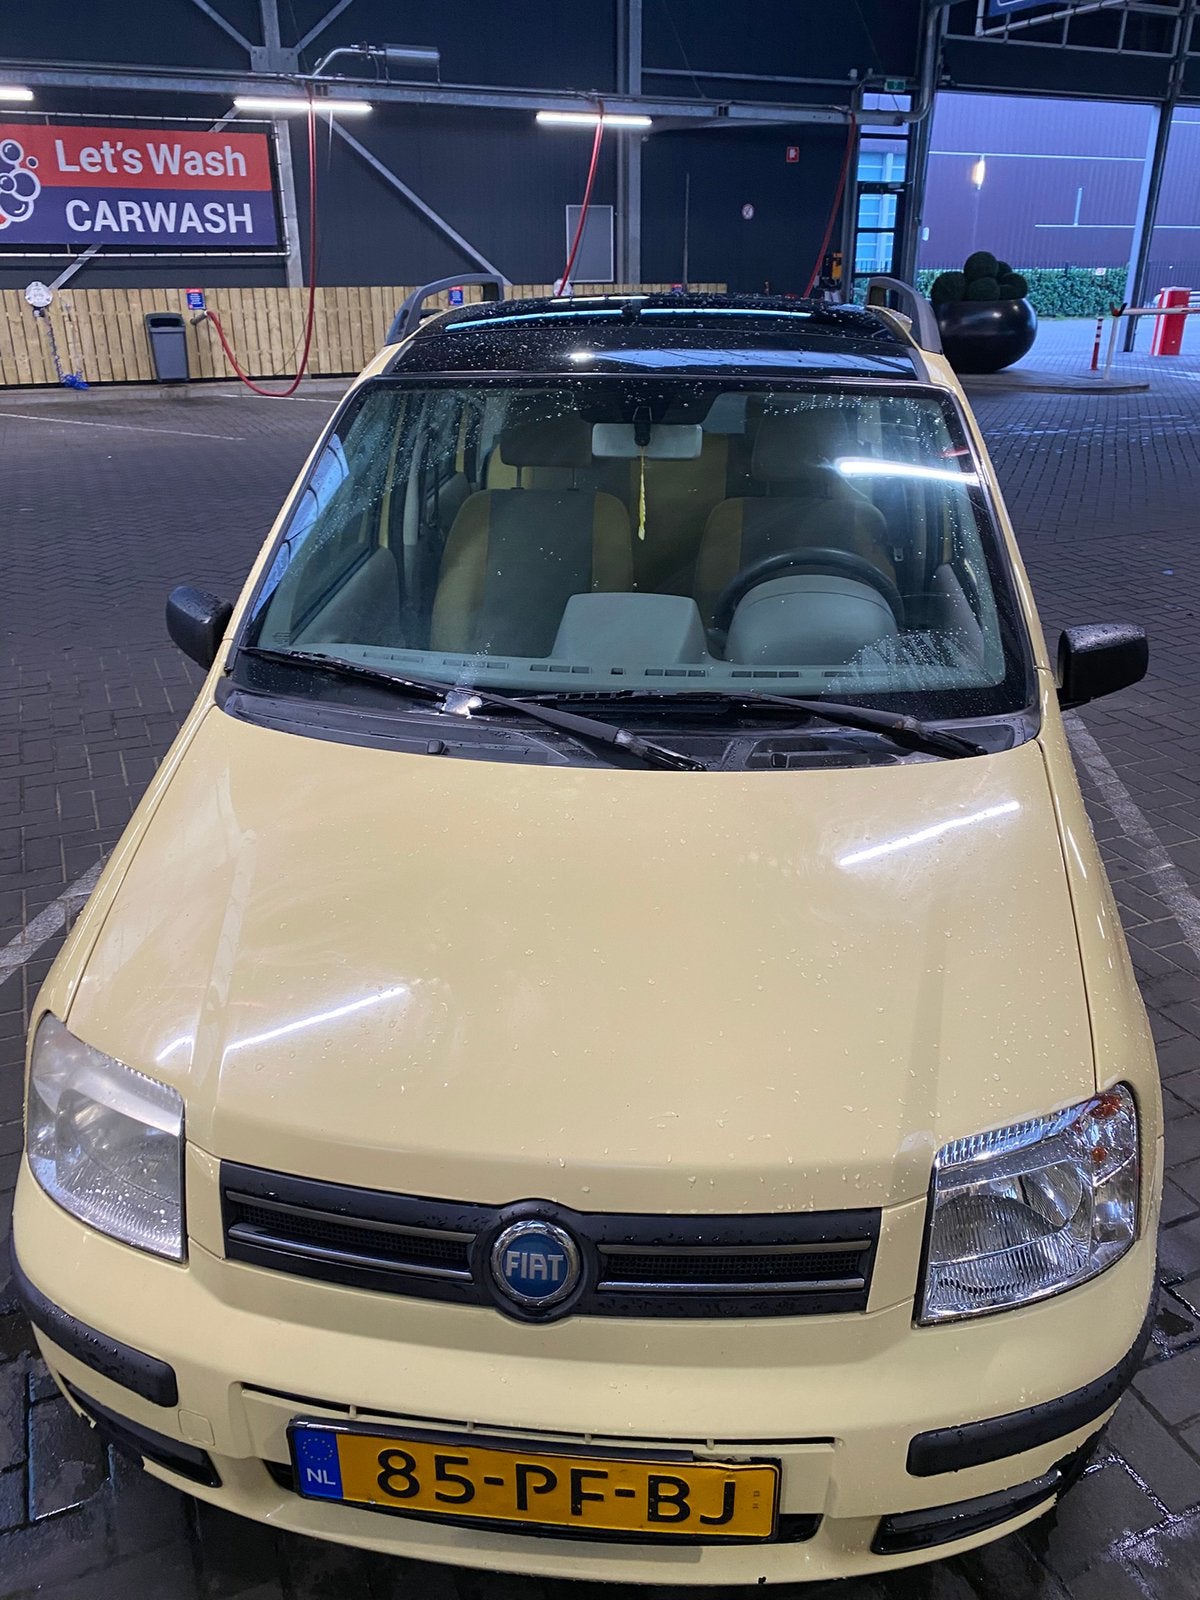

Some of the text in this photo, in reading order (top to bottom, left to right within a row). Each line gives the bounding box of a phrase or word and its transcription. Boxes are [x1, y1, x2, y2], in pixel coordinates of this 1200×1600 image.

[54, 139, 247, 177] Let's Wash
[65, 199, 254, 234] CARWASH
[505, 1250, 565, 1281] FIAT
[306, 1467, 336, 1486] NL
[376, 1447, 737, 1526] 85-PF-BJ
